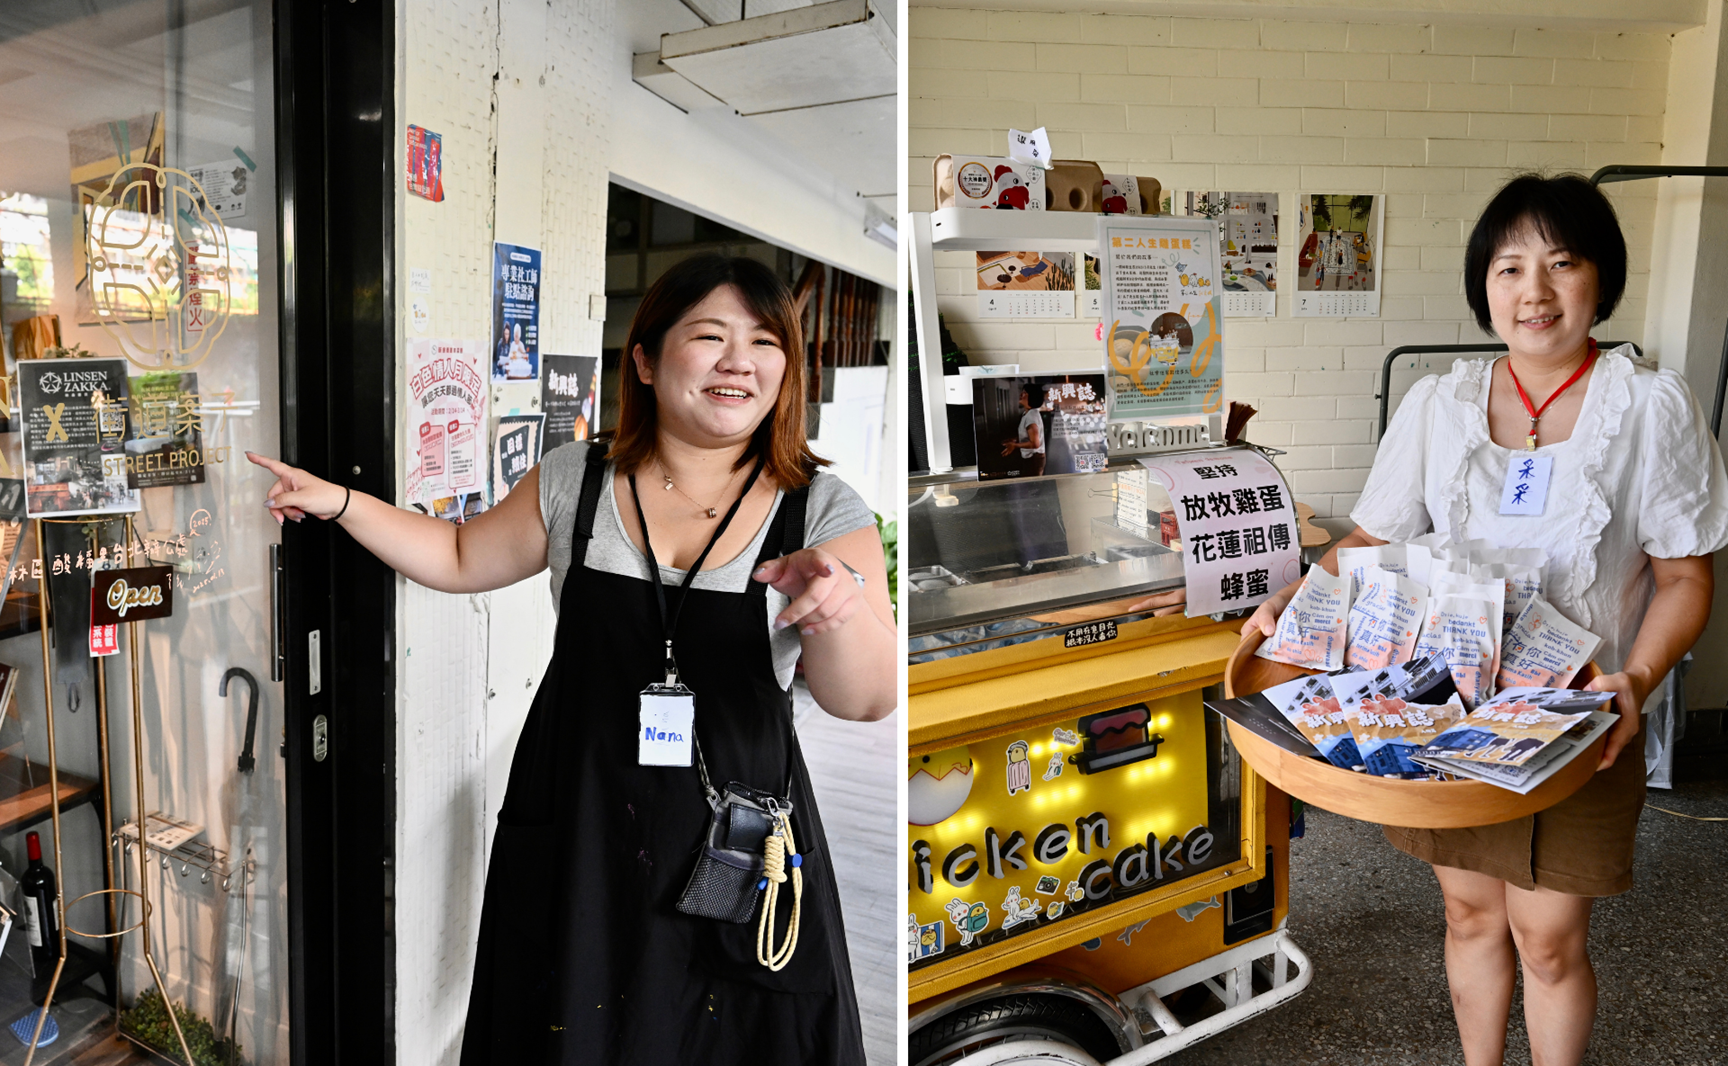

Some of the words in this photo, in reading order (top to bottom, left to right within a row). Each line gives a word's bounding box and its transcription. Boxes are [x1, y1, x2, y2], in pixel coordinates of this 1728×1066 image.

[1112, 237, 1191, 249] 第二人生雞蛋糕
[63, 371, 108, 383] LINSEN
[409, 357, 482, 401] 白色情人月限定
[64, 382, 109, 393] ZAKKA
[1048, 382, 1096, 402] 新興誌
[104, 452, 164, 477] STREET
[169, 446, 232, 470] PROJECT
[1193, 464, 1238, 480] 堅持
[1180, 484, 1285, 522] 放牧雞蛋
[1190, 523, 1291, 564] 花蓮祖傳
[1220, 568, 1269, 601] 蜂蜜
[107, 579, 163, 617] Open
[1401, 607, 1416, 617] YOU
[1067, 621, 1115, 638] 不用在意目光
[1442, 625, 1468, 635] THANK
[1470, 629, 1486, 638] YOU
[1448, 619, 1475, 628] bedankt
[1539, 632, 1562, 646] THANK
[1565, 643, 1580, 654] YOU
[1547, 629, 1573, 644] bedankt
[1512, 642, 1542, 658] 有你
[1504, 652, 1533, 670] 真好
[1543, 657, 1561, 667] merci
[1358, 710, 1435, 728] 新興誌
[1472, 710, 1542, 725] 新興誌
[645, 726, 684, 743] Nana
[908, 811, 1110, 894] icken
[1077, 824, 1214, 900] cake
